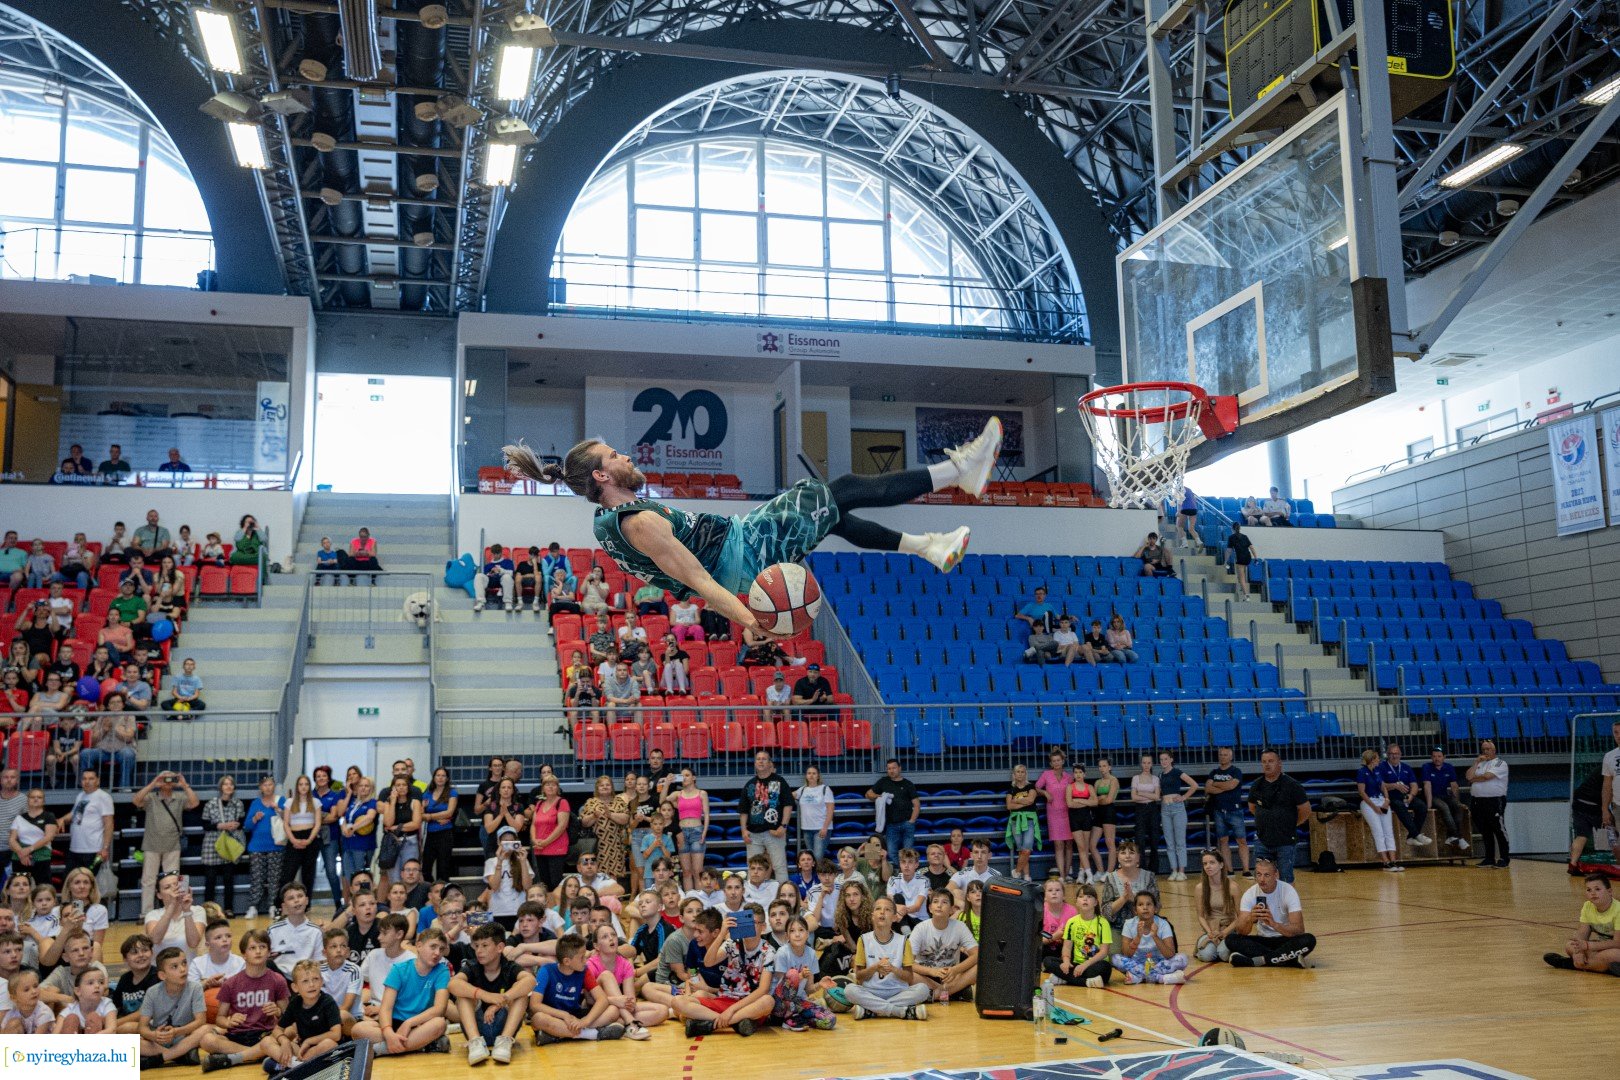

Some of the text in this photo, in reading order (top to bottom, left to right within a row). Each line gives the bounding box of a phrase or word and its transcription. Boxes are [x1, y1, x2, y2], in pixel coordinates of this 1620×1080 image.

[788, 333, 840, 347] Eissmann
[789, 346, 808, 354] Group
[632, 387, 728, 450] 20
[665, 445, 723, 459] Eissmann
[1271, 947, 1309, 963] adidas
